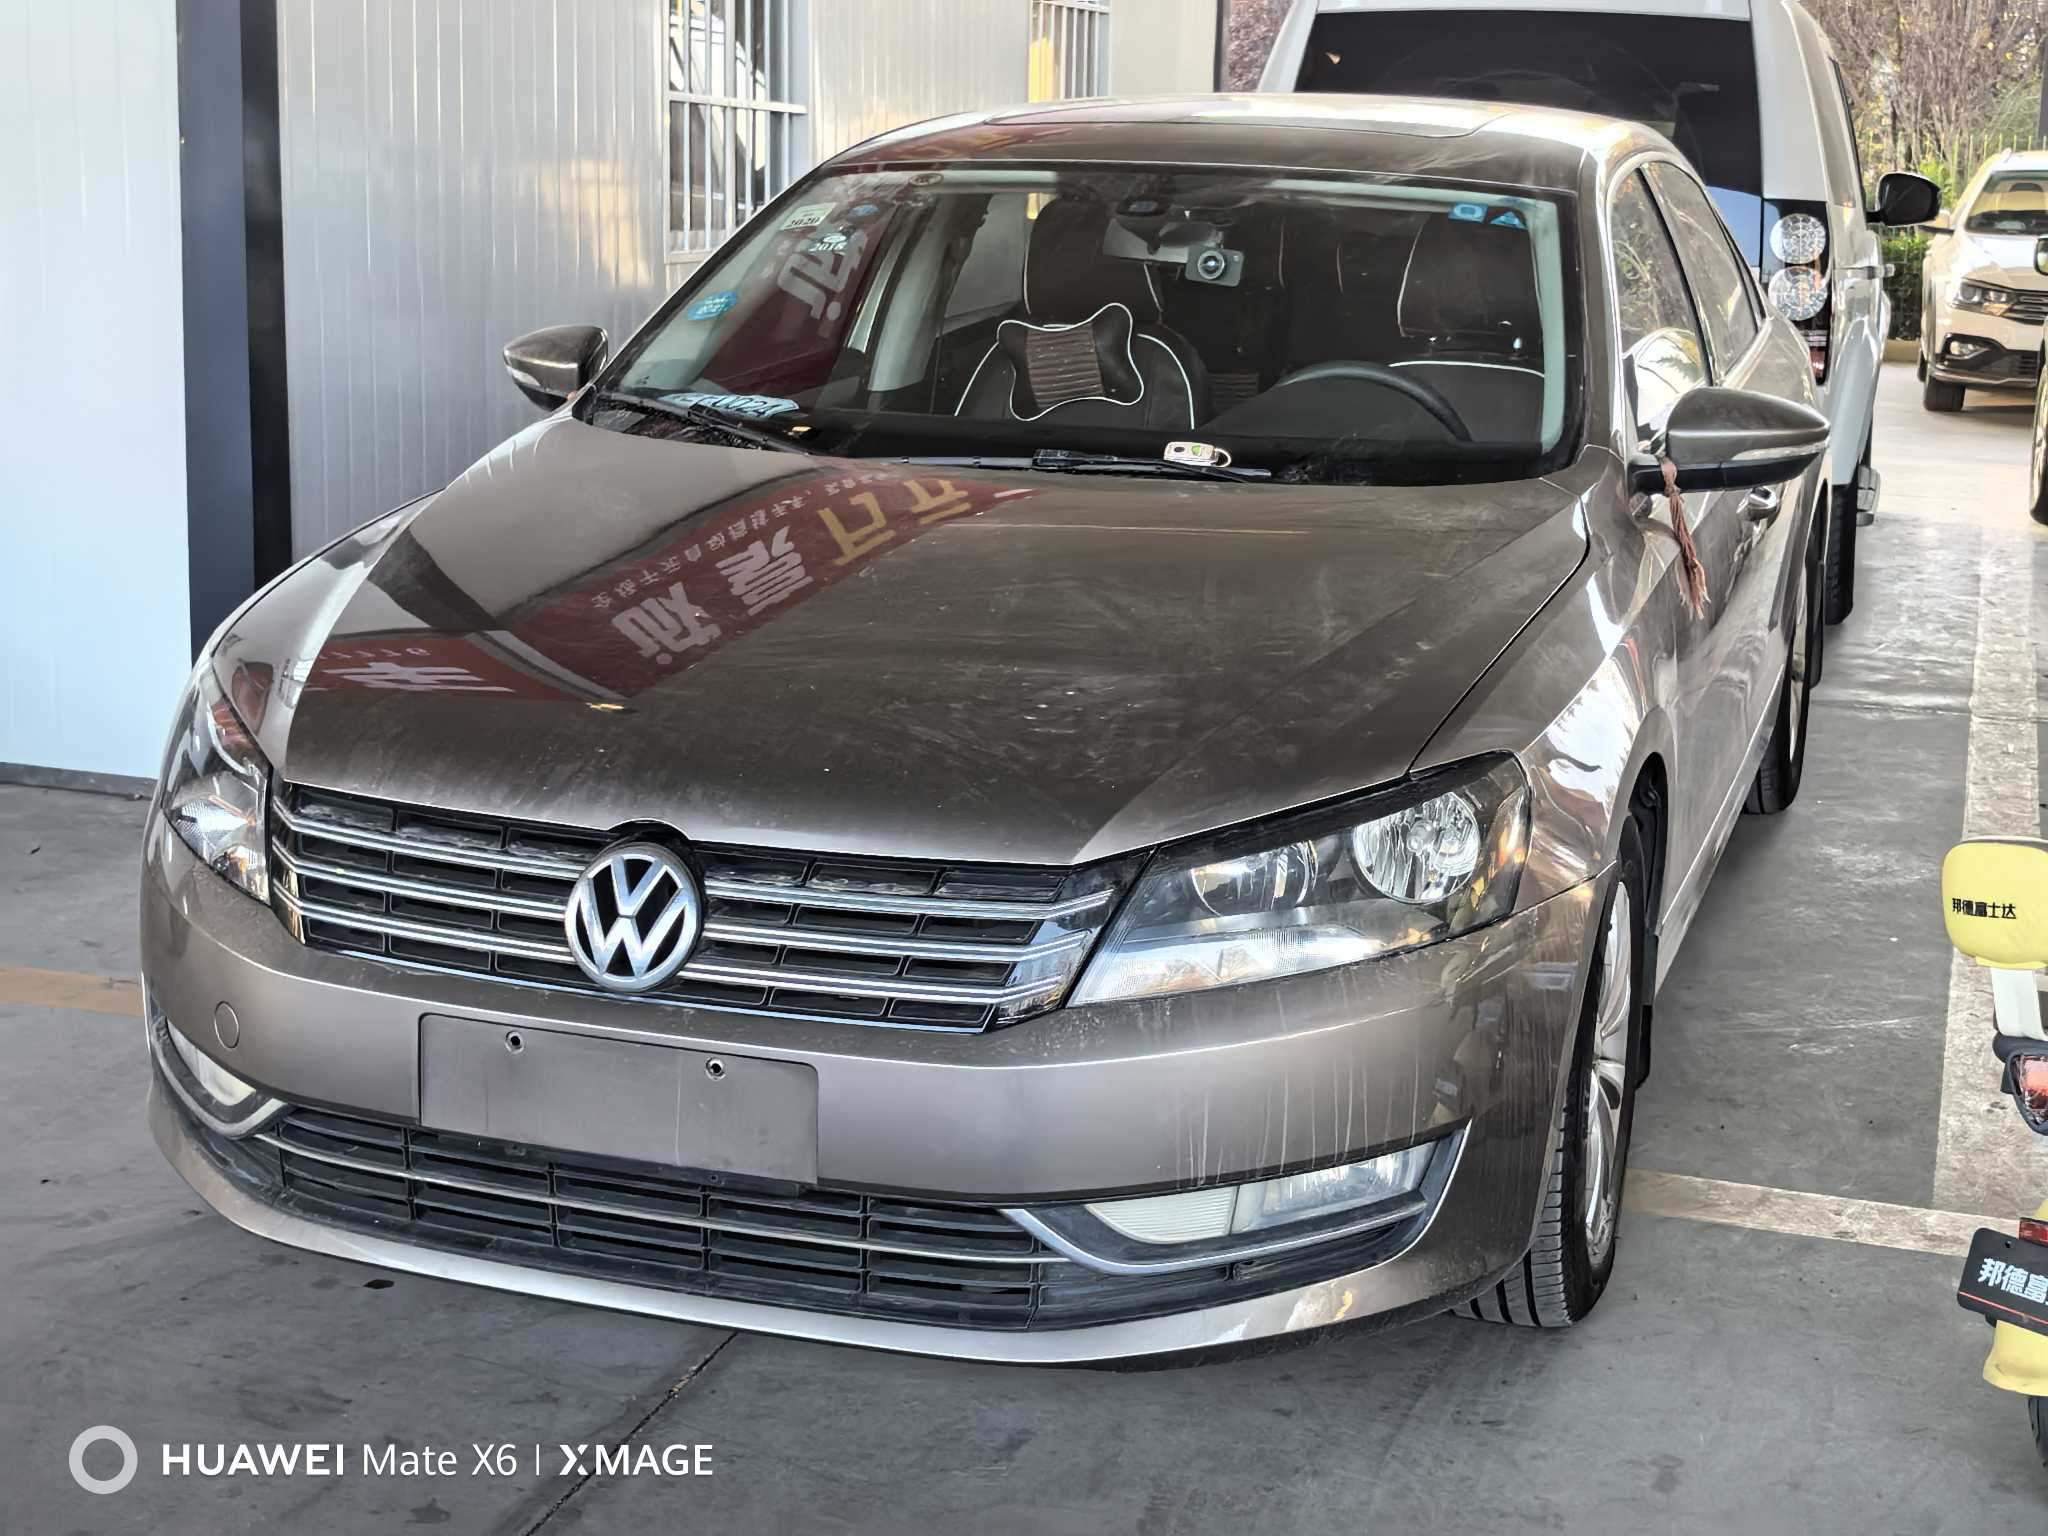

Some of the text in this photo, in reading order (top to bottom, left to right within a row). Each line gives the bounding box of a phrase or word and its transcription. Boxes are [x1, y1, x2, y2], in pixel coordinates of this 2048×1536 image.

[566, 845, 704, 991] VW
[1977, 1257, 2048, 1306] 邦德富
